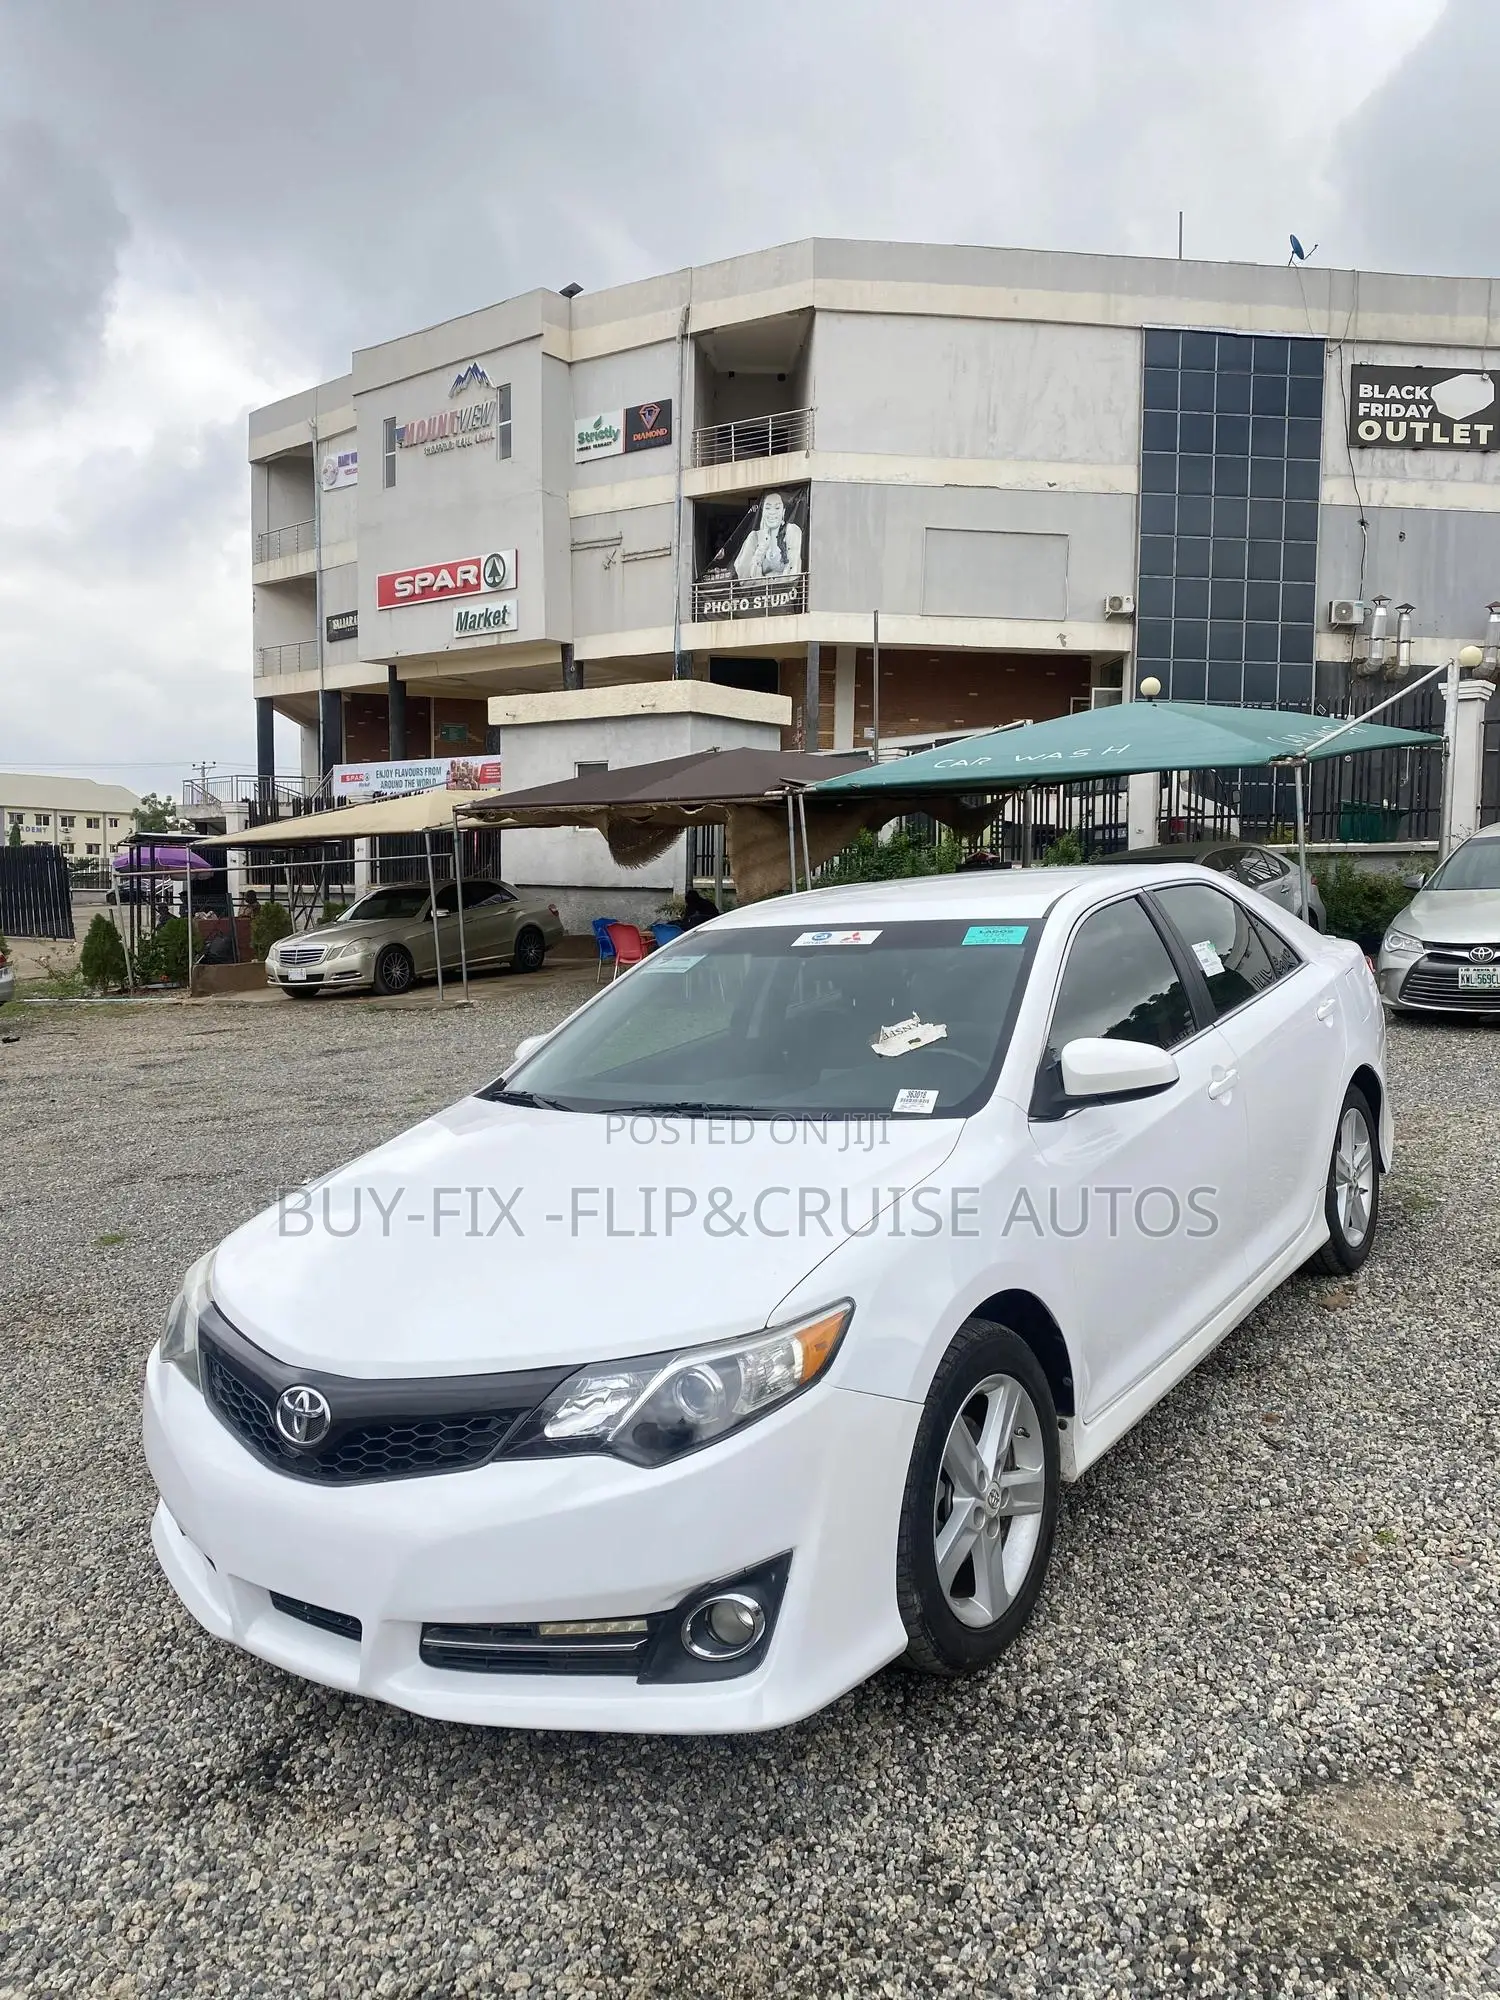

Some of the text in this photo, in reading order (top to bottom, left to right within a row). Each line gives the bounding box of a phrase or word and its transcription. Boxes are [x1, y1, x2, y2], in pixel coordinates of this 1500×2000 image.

[1359, 383, 1430, 400] BLACK
[1358, 402, 1433, 419] FRIDAY
[577, 424, 621, 445] Strictly
[632, 428, 668, 442] DIAMOND
[1357, 419, 1494, 445] OUTLET
[394, 564, 479, 598] SPAR
[703, 598, 750, 614] PHOTO
[455, 604, 508, 632] Market
[933, 756, 992, 769] CAR
[346, 774, 364, 782] SPAR
[376, 766, 442, 779] ENJOY FLAVOURS FROM
[380, 780, 403, 789] AROUND
[404, 779, 415, 788] THE
